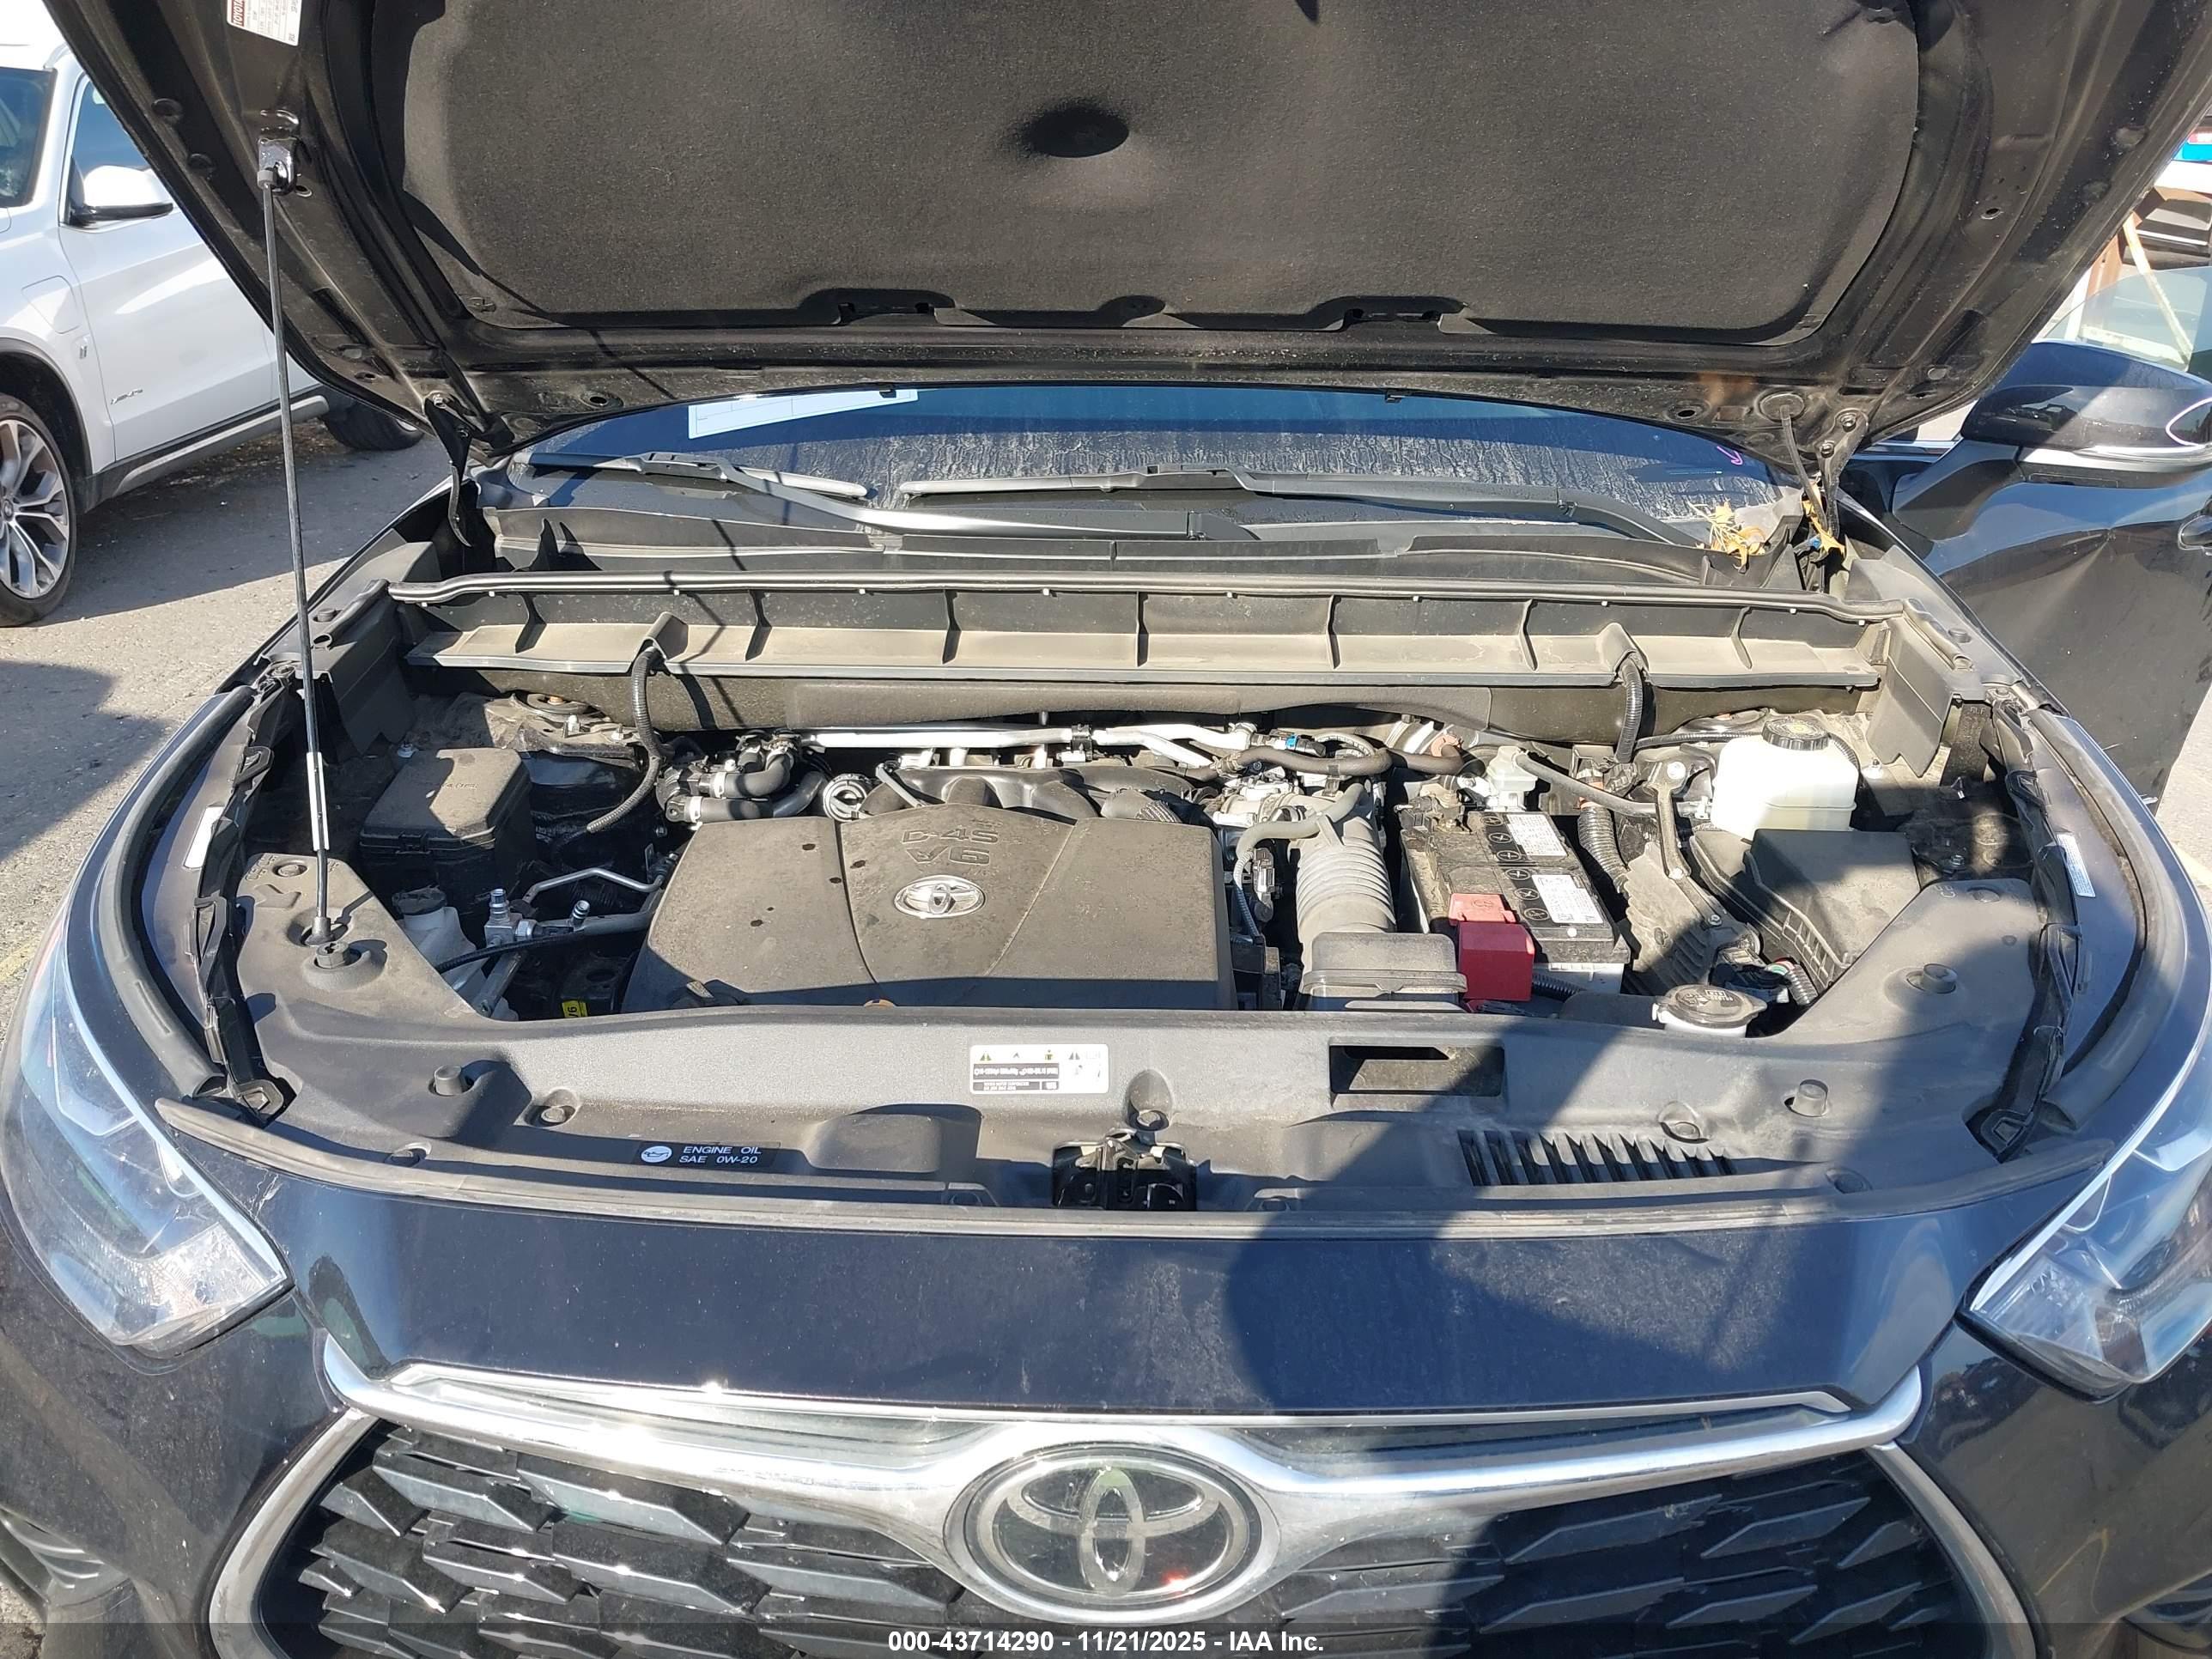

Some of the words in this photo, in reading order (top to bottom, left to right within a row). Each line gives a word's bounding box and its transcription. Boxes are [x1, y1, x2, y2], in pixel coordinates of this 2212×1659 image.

[902, 829, 999, 844] D-4S
[905, 845, 990, 866] V6
[683, 1146, 733, 1155] ENGINE
[740, 1146, 763, 1155] OIL
[679, 1155, 708, 1164] SAE
